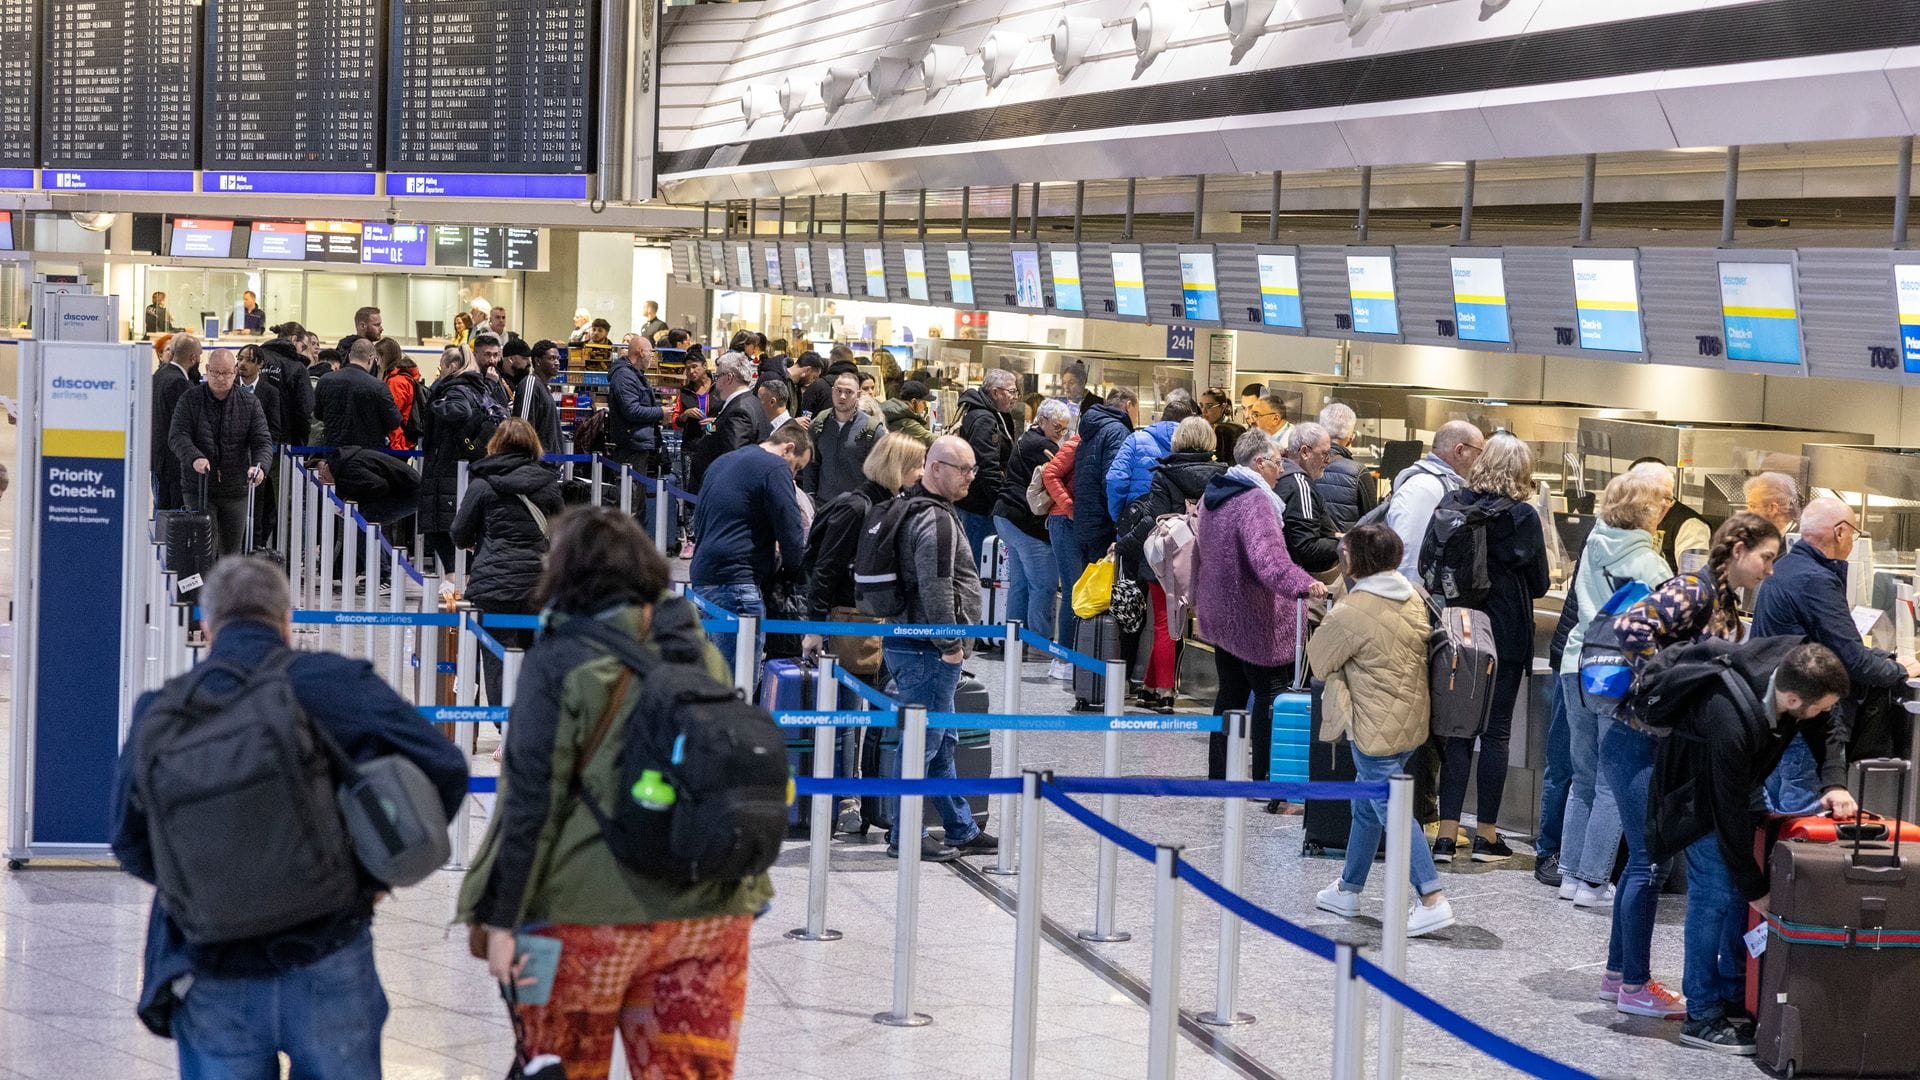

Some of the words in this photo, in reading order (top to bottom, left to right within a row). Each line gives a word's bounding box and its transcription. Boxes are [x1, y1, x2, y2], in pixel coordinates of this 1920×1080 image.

[1171, 336, 1193, 350] 24h
[52, 376, 116, 390] discover
[50, 468, 103, 484] Priority
[49, 484, 116, 498] Check-in
[79, 516, 110, 524] Economy
